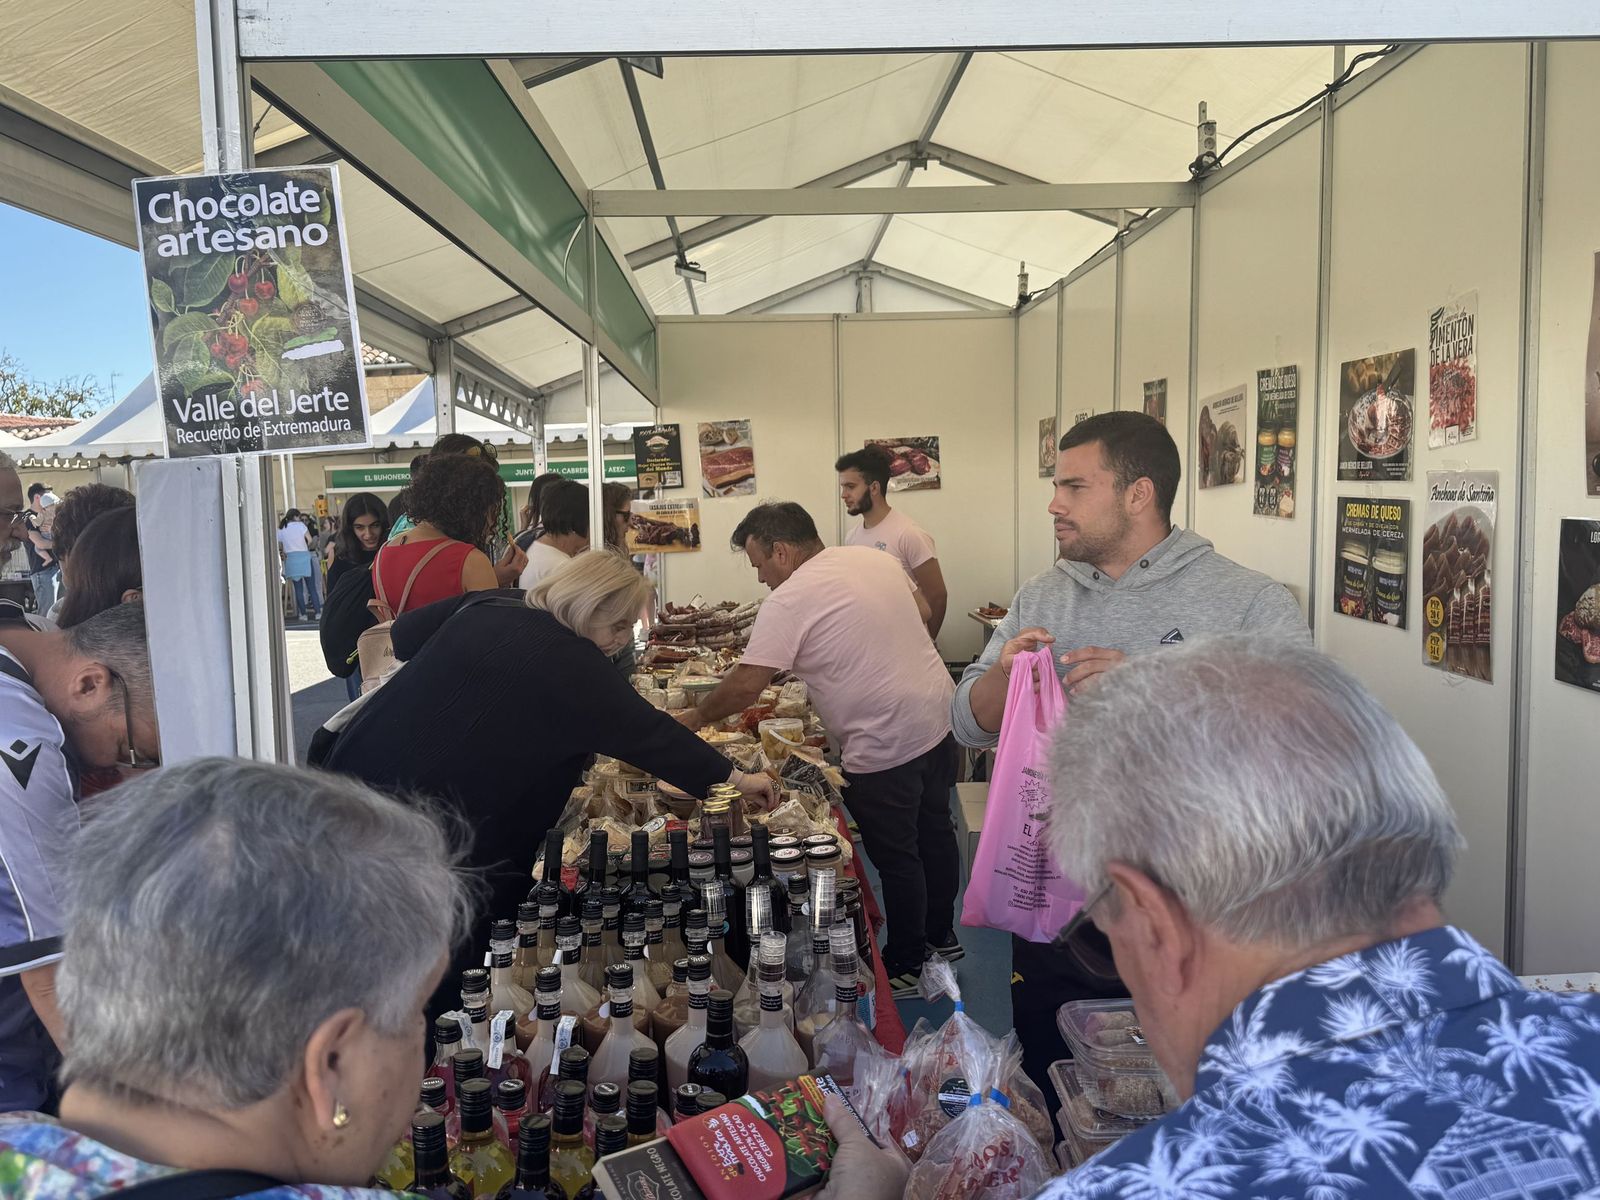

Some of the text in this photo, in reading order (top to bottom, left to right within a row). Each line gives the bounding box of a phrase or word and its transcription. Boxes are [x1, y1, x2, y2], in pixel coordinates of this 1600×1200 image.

[148, 180, 321, 224] Chocolate
[157, 221, 329, 257] artesano
[1453, 336, 1474, 358] VERA
[173, 386, 350, 424] Valle del Jerte
[176, 416, 351, 444] Recuerdo de Extremadura
[1430, 482, 1456, 501] Anchoas
[1457, 482, 1465, 501] de
[1346, 504, 1402, 522] CREMAS DE QUESO
[1342, 527, 1371, 535] MERMELADA
[1382, 530, 1405, 539] CEREZA
[732, 1114, 750, 1137] CACAO
[719, 1112, 767, 1182] CHOCOLATE ARTESANO
[747, 1122, 774, 1158] CEREZAS
[645, 1146, 668, 1174] NEGRO
[754, 1149, 773, 1173] NEGRO
